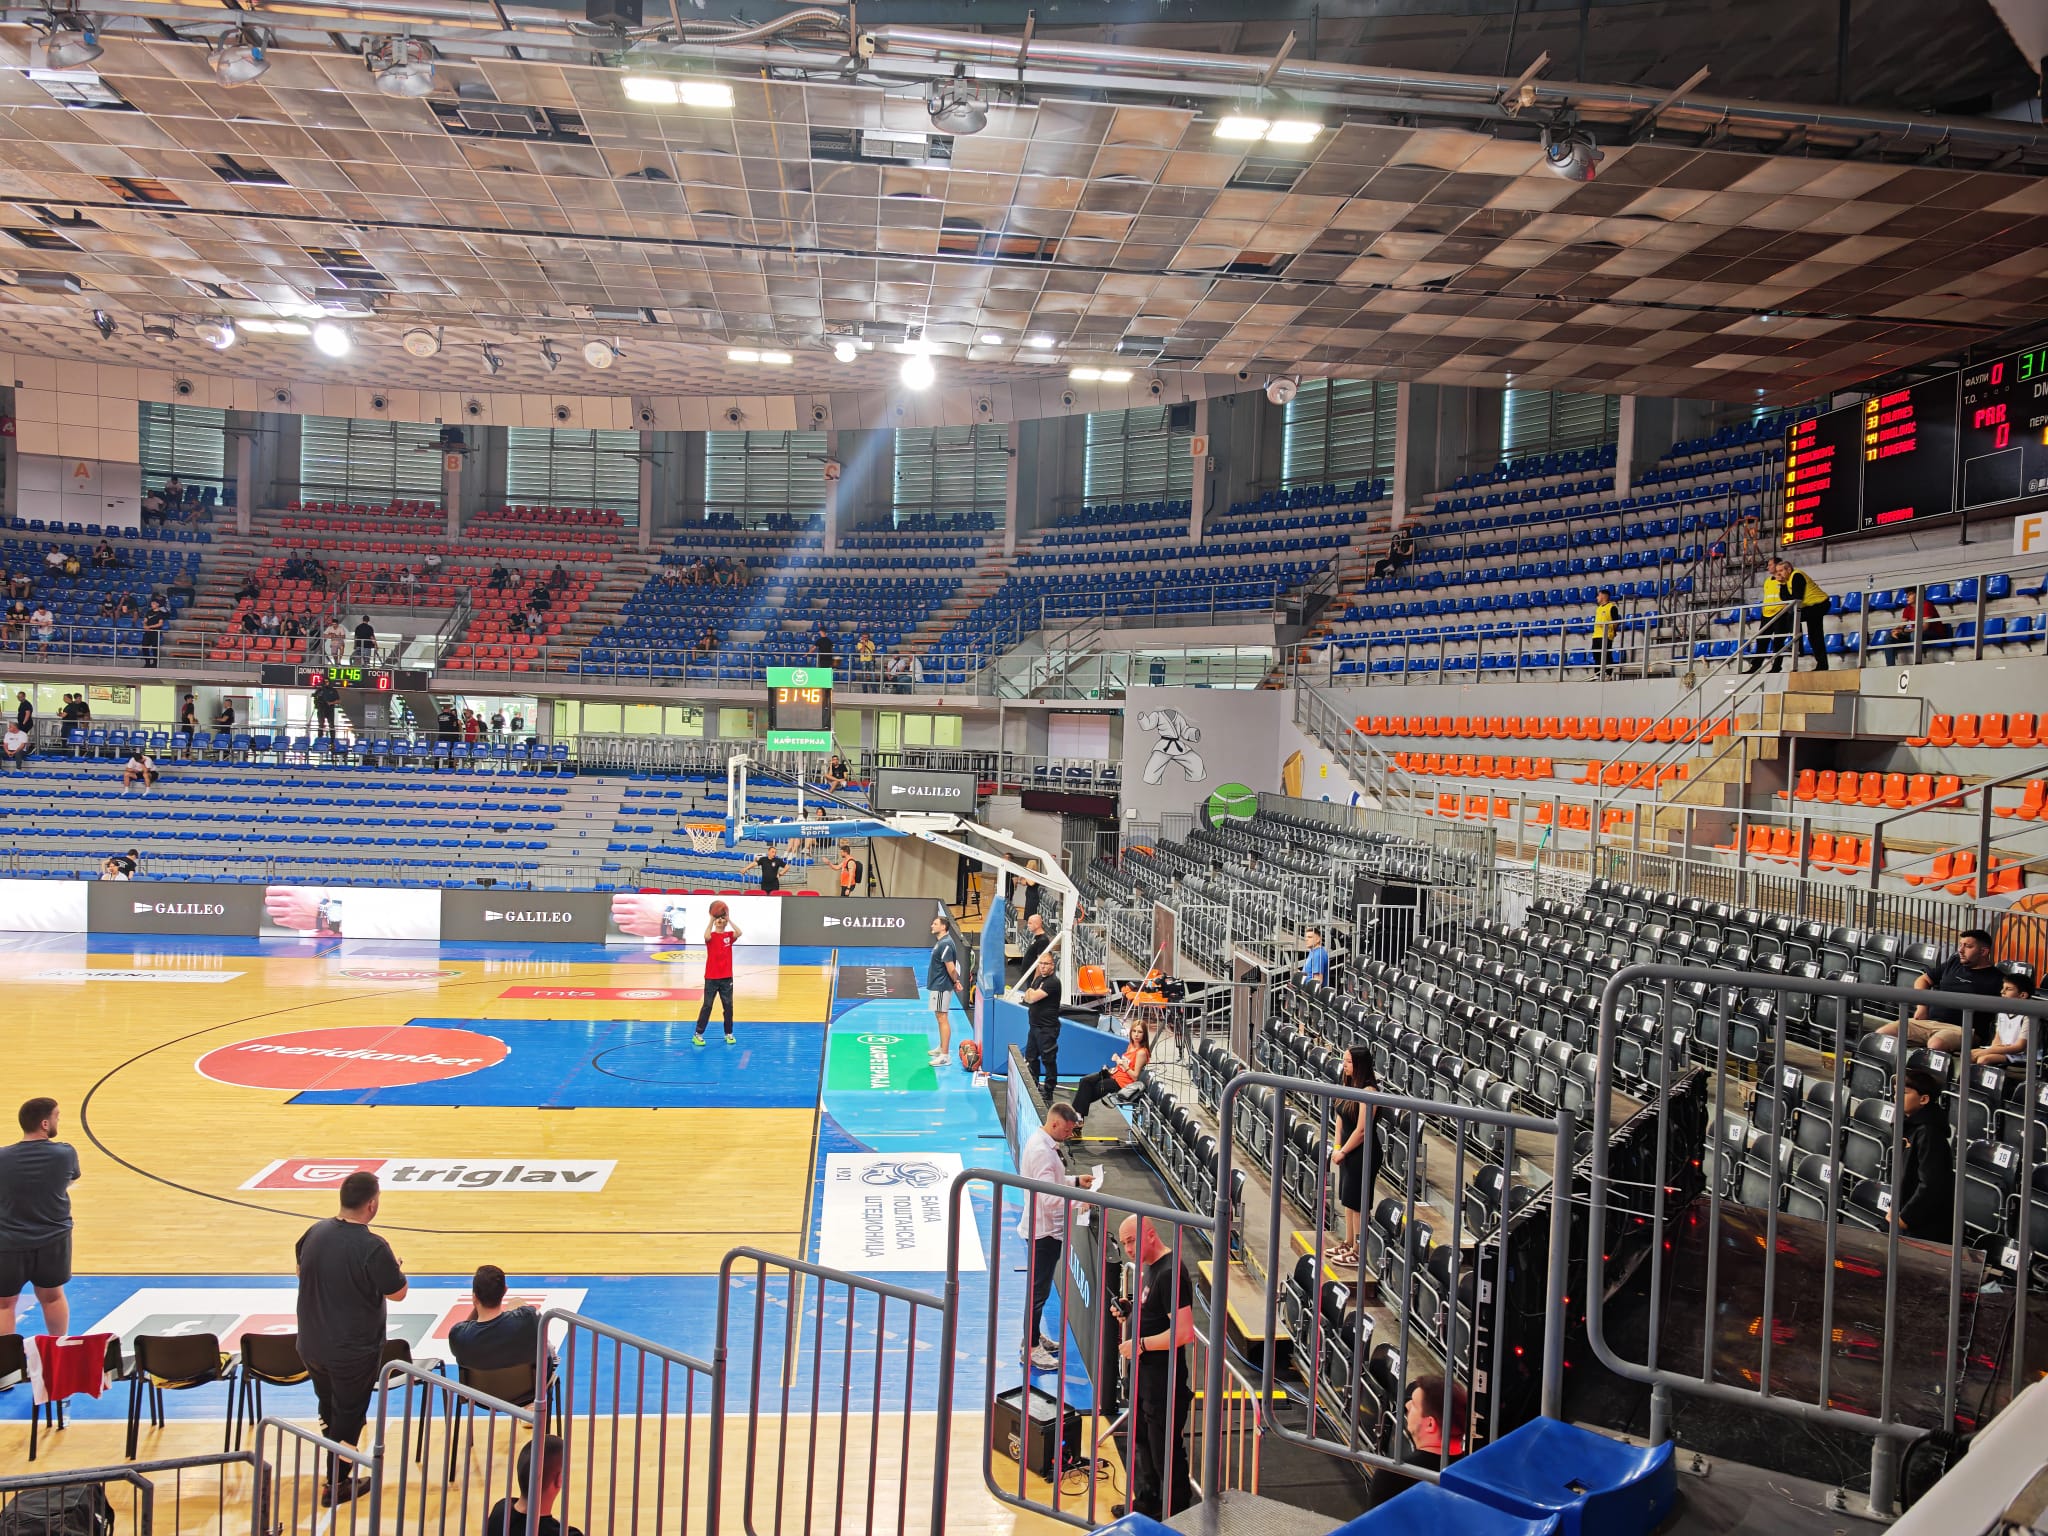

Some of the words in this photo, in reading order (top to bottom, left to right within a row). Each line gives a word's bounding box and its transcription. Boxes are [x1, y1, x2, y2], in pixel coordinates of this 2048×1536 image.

[1965, 373, 1989, 387] ФАУЛИ
[1991, 362, 2004, 384] 0
[1975, 403, 2007, 429] PAR
[1994, 422, 2010, 448] 0
[1193, 438, 1205, 455] D
[73, 462, 90, 479] A
[448, 455, 460, 470] B
[2022, 517, 2043, 552] F
[1900, 673, 1908, 690] C
[774, 737, 825, 745] КАФЕТЕРИЈА
[908, 786, 961, 797] GALILEO
[155, 903, 225, 915] GALILEO
[505, 911, 573, 923] GALILEO
[842, 917, 905, 928] GALILEO
[533, 989, 596, 997] mts
[238, 1043, 483, 1067] meridianbet
[392, 1165, 598, 1188] triglav
[921, 1195, 942, 1223] БАНКА
[861, 1195, 885, 1258] ШТЕДИОНИЦА
[893, 1195, 916, 1250] ПОШТАНСКА
[2006, 1254, 2017, 1265] 21
